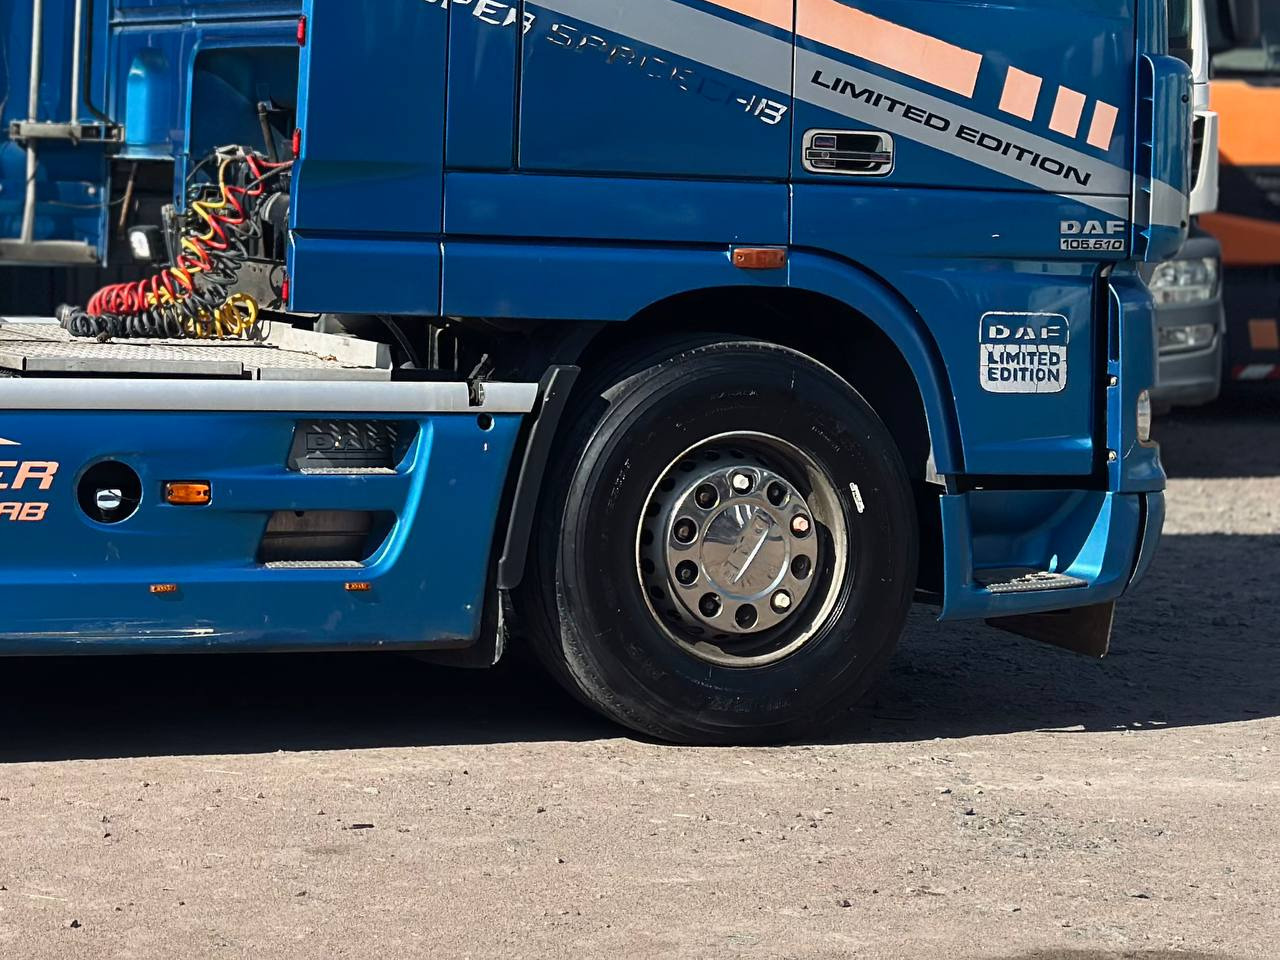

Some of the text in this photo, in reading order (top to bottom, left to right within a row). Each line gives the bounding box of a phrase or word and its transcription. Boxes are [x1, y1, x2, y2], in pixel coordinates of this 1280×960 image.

[811, 70, 1092, 187] LIMITED EDITION
[1060, 220, 1125, 235] DAF
[988, 325, 1061, 340] DAF
[987, 351, 1061, 366] LIMITED
[987, 366, 1060, 382] EDITION
